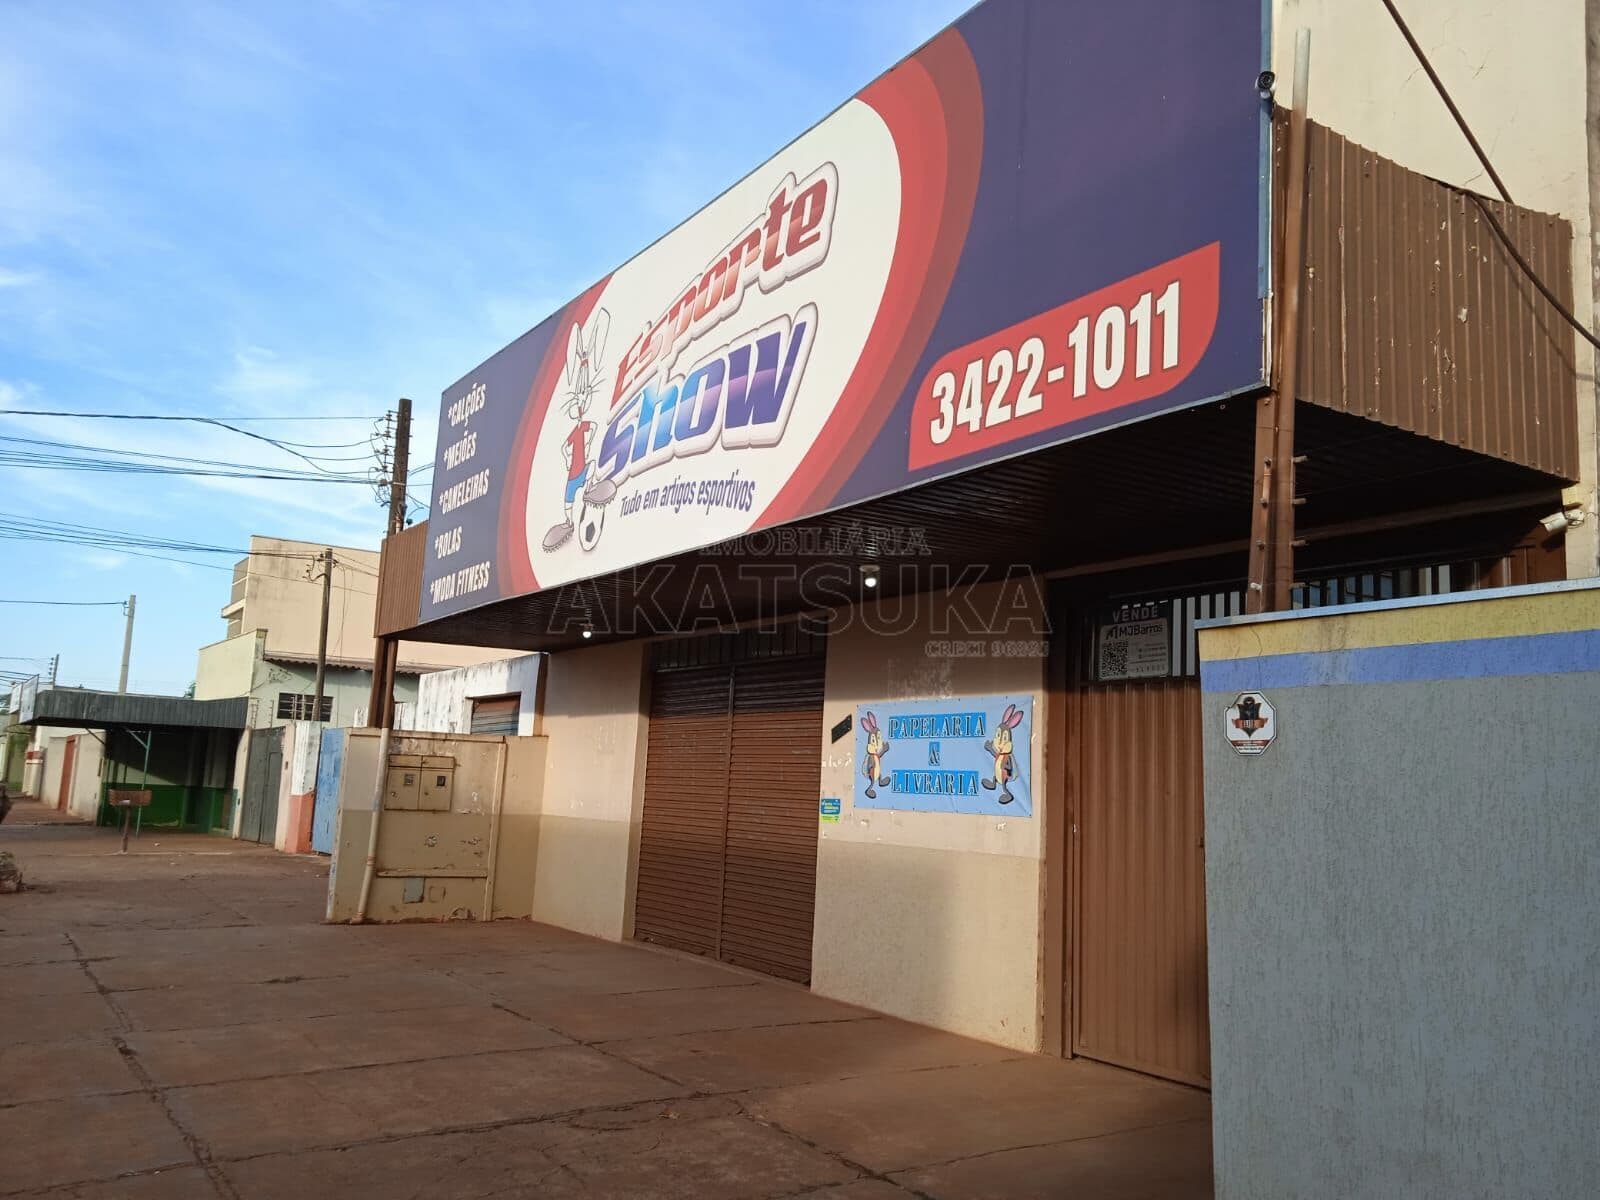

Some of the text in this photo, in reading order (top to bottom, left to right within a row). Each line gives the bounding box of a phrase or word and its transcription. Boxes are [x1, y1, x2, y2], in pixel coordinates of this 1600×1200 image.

[609, 177, 829, 411] Esporte
[929, 280, 1180, 445] 3422-1011
[620, 468, 755, 518] Tudo em artigos esportivos
[456, 561, 490, 597] FITNESS
[1112, 604, 1159, 623] VENDE
[889, 714, 986, 738] PAPELARIA
[929, 746, 940, 766] &
[892, 770, 979, 795] LIVRARIA
